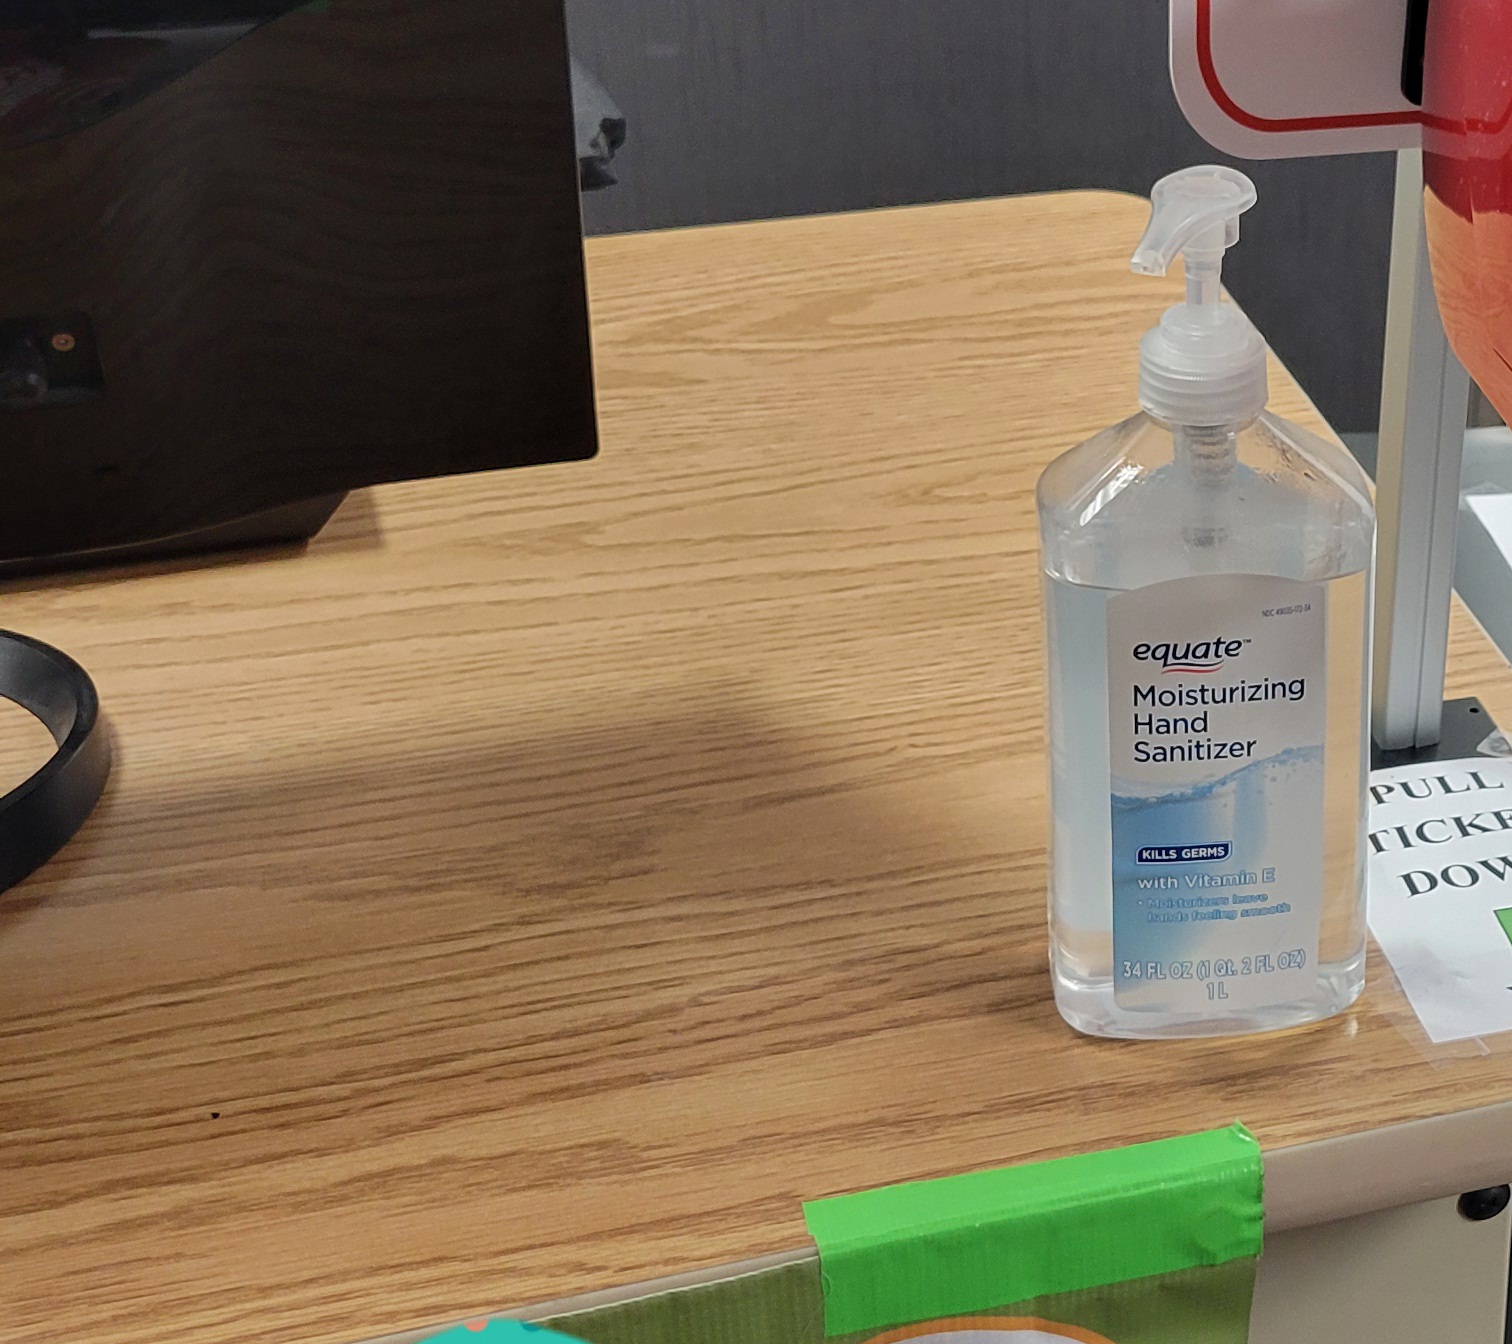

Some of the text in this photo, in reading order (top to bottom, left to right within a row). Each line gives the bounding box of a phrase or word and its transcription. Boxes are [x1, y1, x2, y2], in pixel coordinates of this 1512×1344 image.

[1132, 677, 1306, 708] Moisturizing
[1133, 710, 1209, 735] Hand
[1133, 737, 1257, 764] Sanitizer
[1369, 770, 1504, 806] PULL
[1141, 845, 1226, 861] KILLS GERMS
[1137, 867, 1276, 890] with Vitamin E
[1148, 891, 1269, 909] Moisturizers leave
[1147, 902, 1291, 924] hands feeling smooth
[1122, 959, 1143, 979] 34
[1146, 960, 1167, 980] FL
[1170, 960, 1194, 980] OZ
[1196, 959, 1211, 982] (1
[1240, 956, 1252, 976] 2
[1255, 953, 1275, 974] FL
[1277, 948, 1307, 971] OZ)
[1206, 981, 1229, 1000] 1 L
